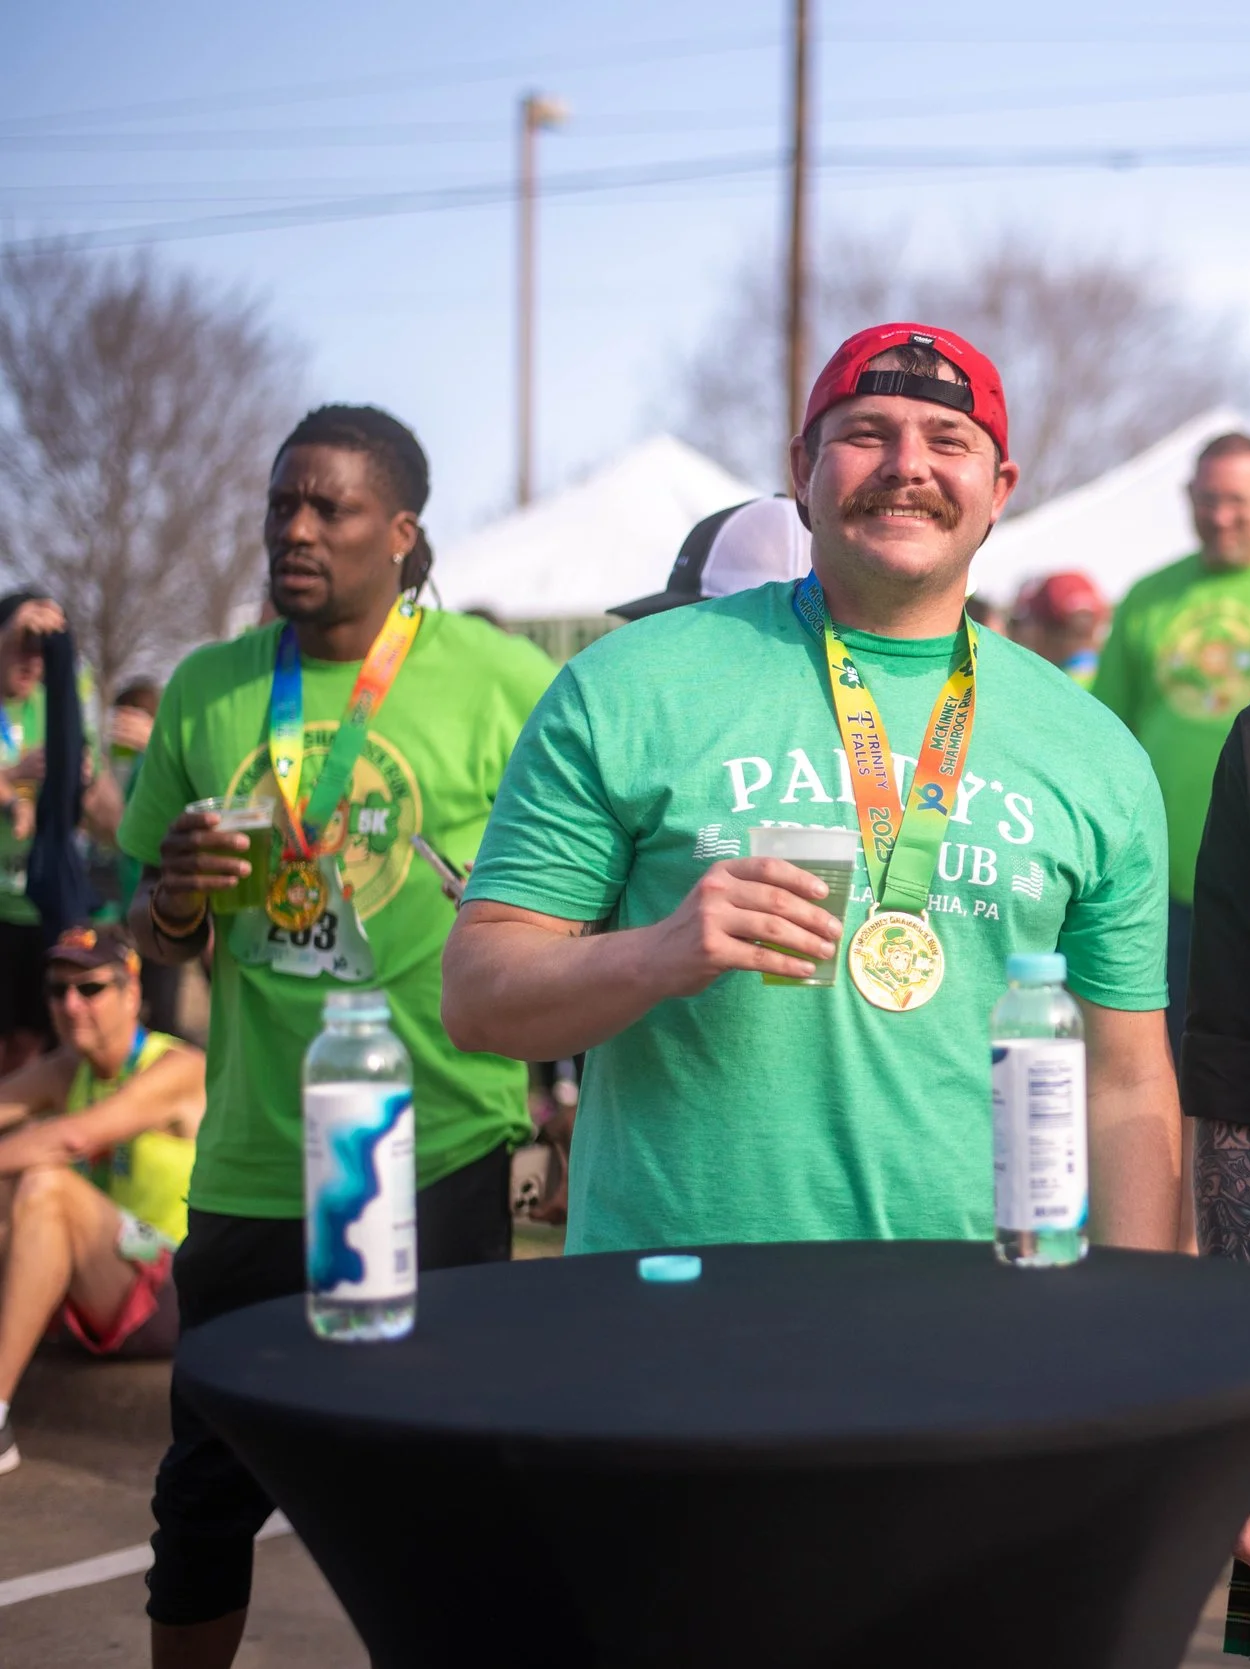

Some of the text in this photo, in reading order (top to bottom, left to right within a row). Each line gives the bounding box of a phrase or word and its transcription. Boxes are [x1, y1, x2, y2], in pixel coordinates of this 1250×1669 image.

[845, 665, 860, 684] 5K
[851, 733, 870, 776] FALLS
[867, 733, 889, 790] TRINITY
[939, 709, 968, 776] SHAMROCK
[358, 808, 390, 835] 5K
[938, 841, 998, 886] UB
[972, 899, 1000, 920] PA
